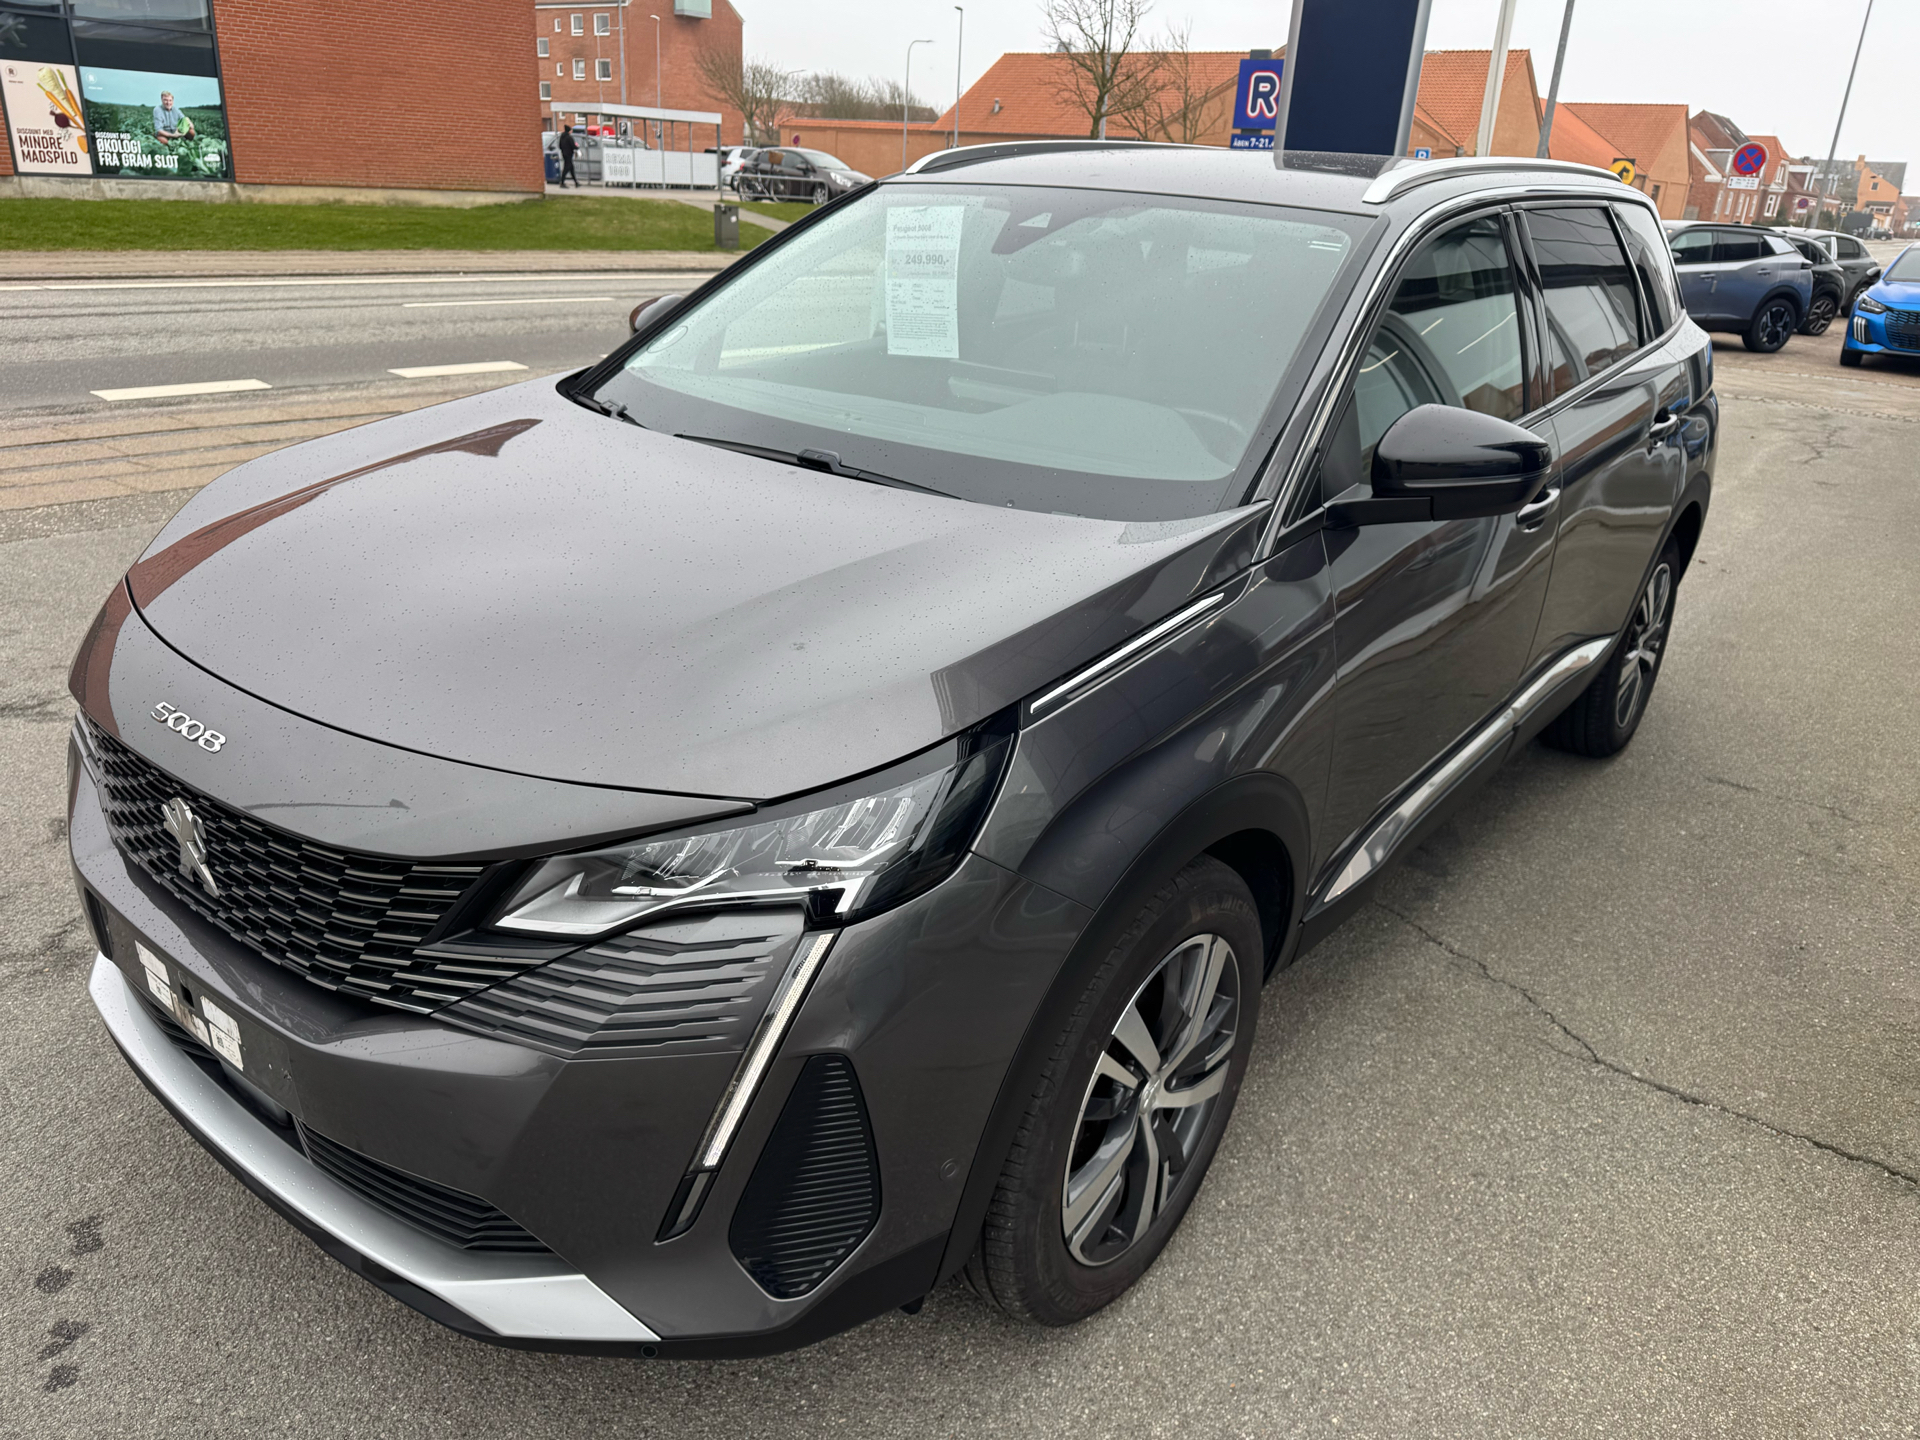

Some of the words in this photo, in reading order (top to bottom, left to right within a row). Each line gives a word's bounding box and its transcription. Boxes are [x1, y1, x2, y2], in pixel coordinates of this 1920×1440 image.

[1247, 71, 1280, 117] R
[16, 127, 41, 135] DISCOUNT
[42, 128, 54, 136] MED
[94, 131, 119, 139] DISCOUNT
[120, 132, 131, 140] MED
[19, 135, 63, 150] MINDRE
[96, 138, 142, 154] ØKOLOGI
[22, 150, 78, 164] MADSPILD
[98, 152, 120, 167] FRA
[121, 153, 153, 168] GRAM
[154, 154, 179, 168] SLOT
[605, 154, 632, 164] REMA
[1418, 150, 1427, 159] P
[609, 166, 630, 176] 1000
[893, 223, 917, 233] Peugeot
[918, 224, 932, 232] 5008
[905, 254, 949, 266] 249.990,-
[150, 701, 227, 754] 5008
